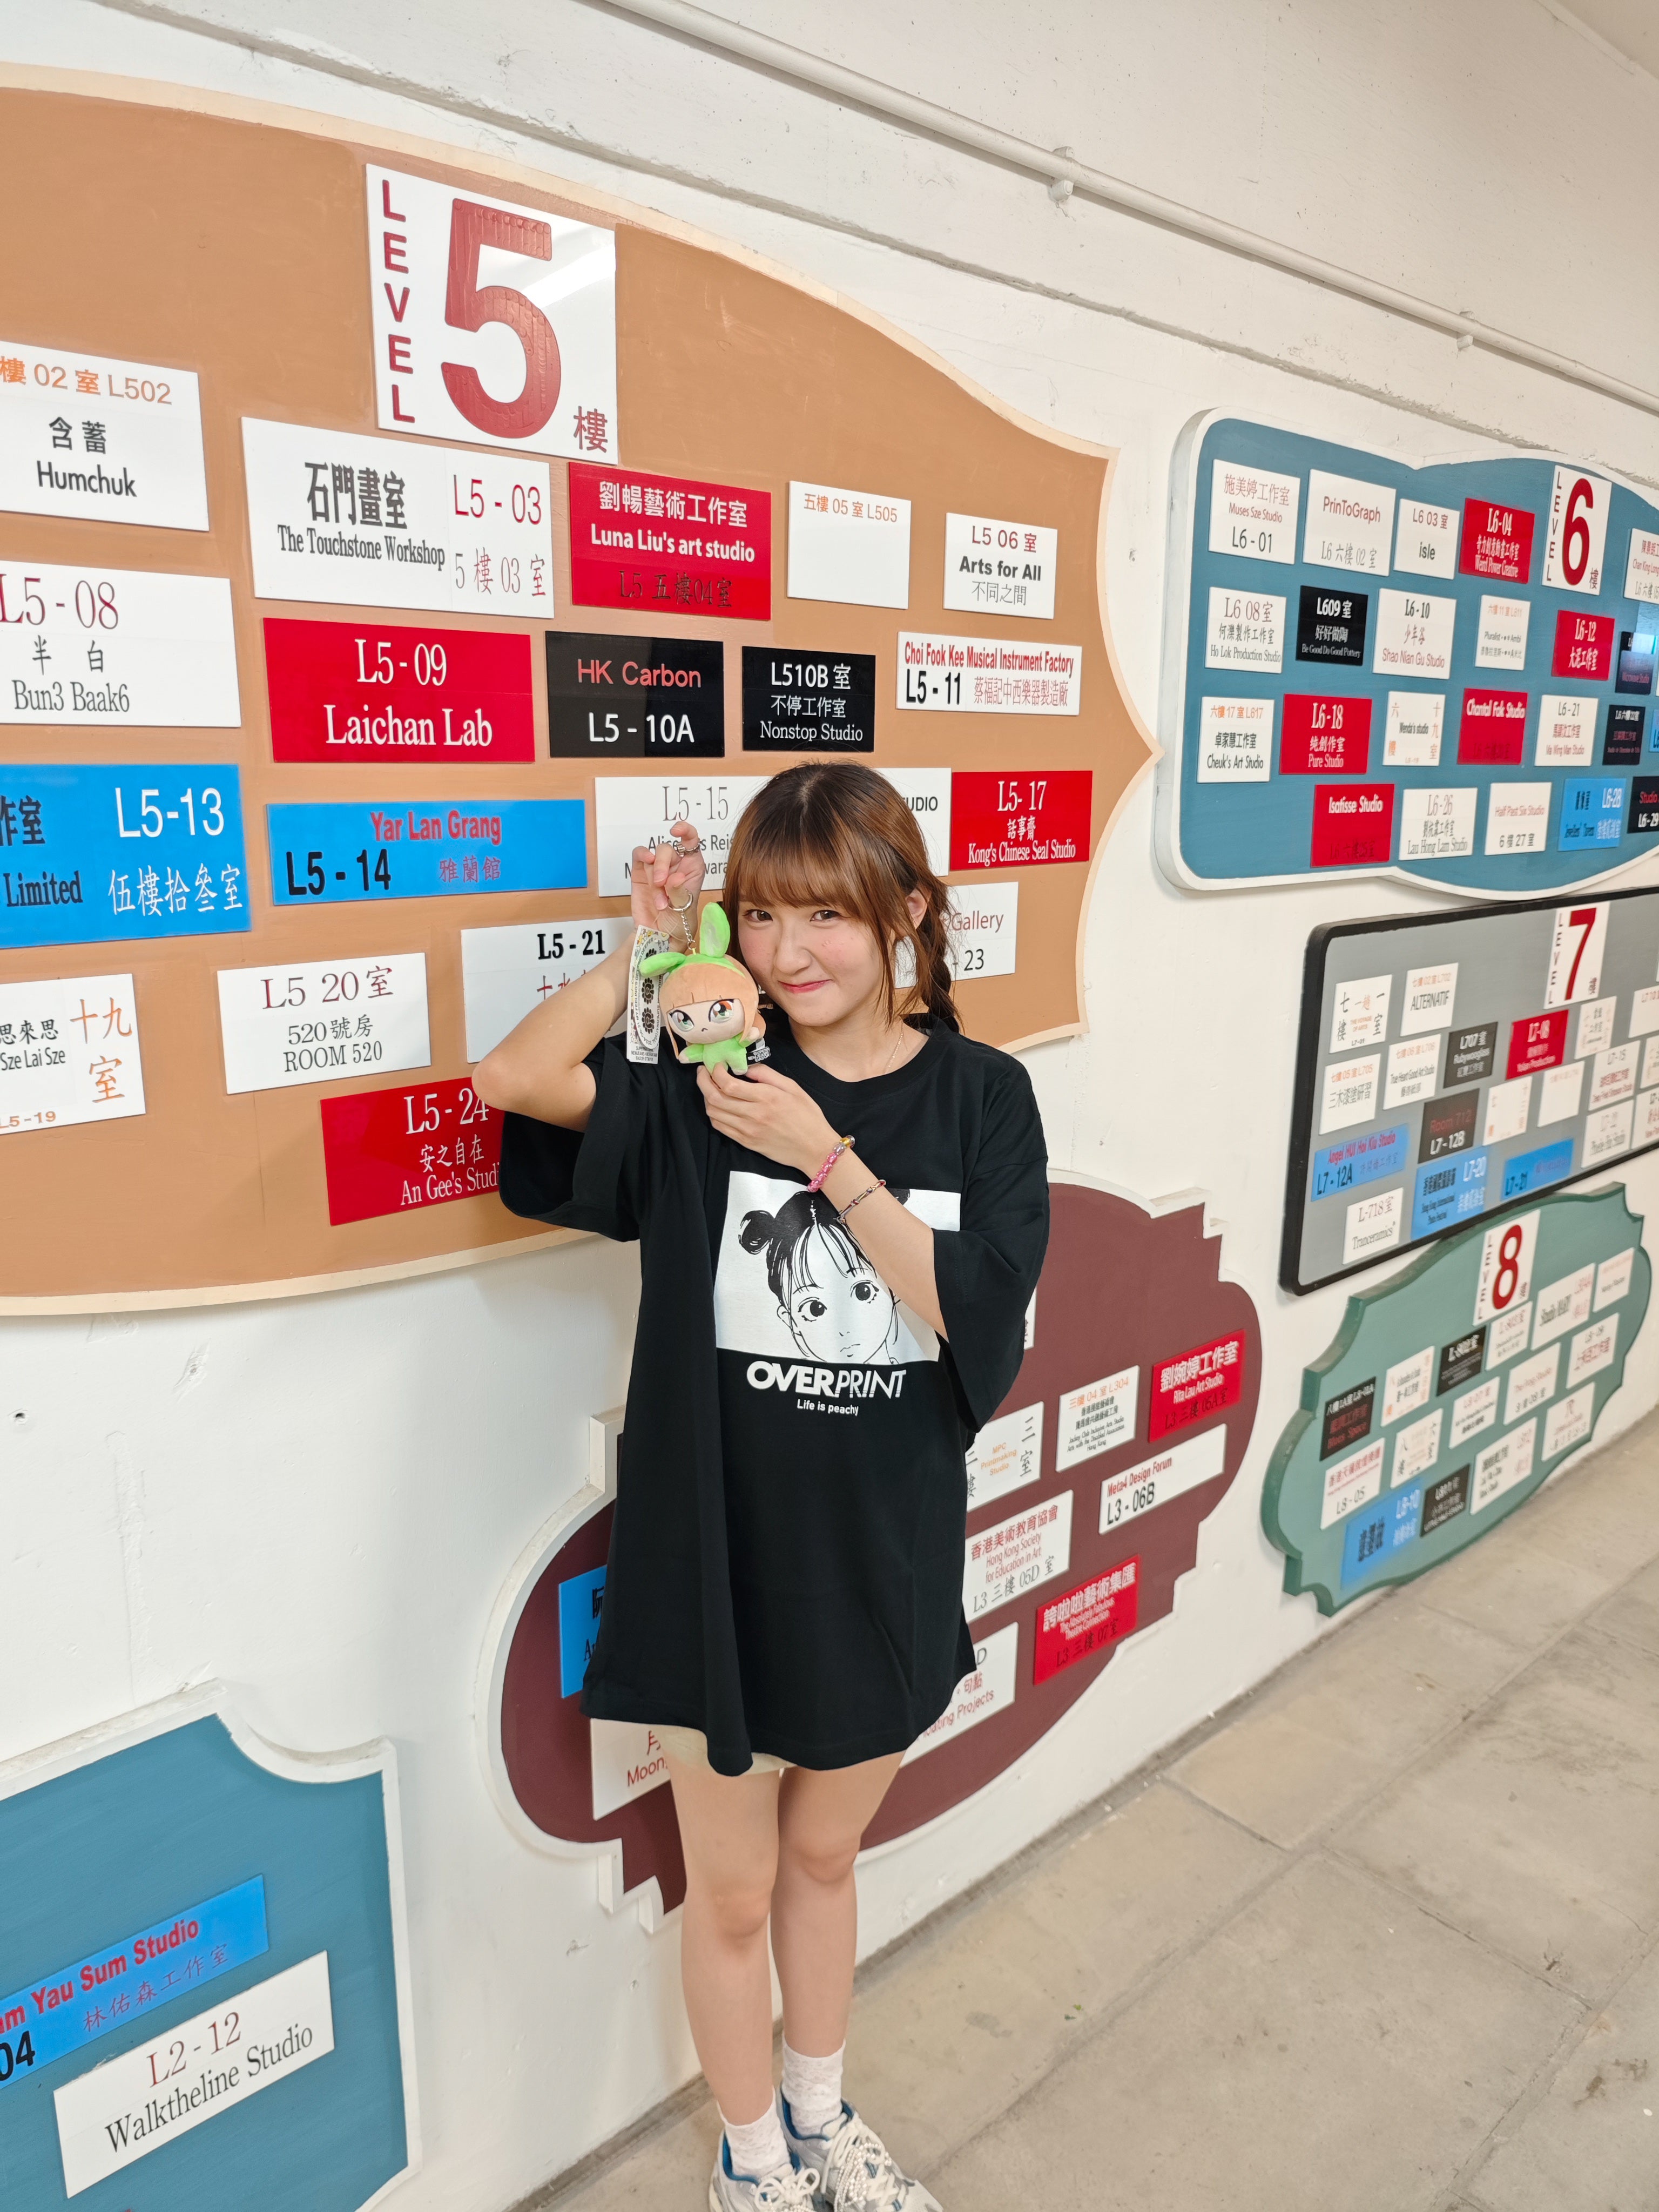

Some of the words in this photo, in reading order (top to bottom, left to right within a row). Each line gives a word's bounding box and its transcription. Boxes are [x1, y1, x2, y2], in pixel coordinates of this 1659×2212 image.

[382, 180, 415, 423] LEVEL
[441, 198, 561, 439] 5
[33, 363, 68, 390] 02
[75, 369, 100, 395] 室
[108, 374, 172, 405] L502
[573, 406, 608, 454] 樓
[36, 460, 137, 497] Humchuk
[1223, 474, 1290, 506] 施美婷工作室
[304, 462, 407, 529] 石門畫室
[599, 481, 747, 528] 劉暢藝術工作室
[804, 493, 828, 513] 五樓
[832, 498, 848, 516] 05
[852, 501, 864, 518] 室
[867, 503, 898, 523] L505
[1323, 496, 1381, 525] PrinToGraph
[1229, 502, 1249, 517] Muses
[1251, 505, 1261, 519] Sze
[1263, 508, 1282, 523] Studio
[1546, 471, 1562, 582] LEVEL
[277, 524, 304, 554] The
[307, 527, 382, 561] Touchstone
[384, 535, 445, 571] Workshop
[591, 523, 633, 549] Luna
[638, 529, 675, 554] Liu's
[679, 538, 703, 557] art
[705, 541, 755, 563] studio
[972, 525, 992, 546] L5
[997, 529, 1018, 550] 06
[1562, 478, 1594, 586] 6
[1419, 542, 1435, 560] isle
[959, 555, 993, 576] Arts
[997, 560, 1018, 578] for
[1022, 564, 1041, 582] All
[971, 581, 1027, 606] 不同之間
[577, 658, 613, 685] HK
[622, 660, 701, 687] Carbon
[771, 662, 828, 687] L510B
[905, 641, 924, 665] Choi
[926, 643, 946, 667] Fook
[948, 644, 965, 668] Kee
[966, 646, 997, 670] Musical
[1000, 649, 1043, 672] Instrument
[1045, 651, 1074, 679] Factory
[1382, 648, 1398, 663] Shao
[1400, 650, 1414, 664] Nian
[1416, 652, 1424, 666] Gu
[1426, 653, 1445, 668] Studio
[11, 679, 64, 711] Bun3
[70, 682, 130, 712] Baak6
[771, 694, 846, 719] 不停工作室
[1506, 701, 1525, 719] Studio
[323, 704, 436, 746] Laichan
[442, 707, 493, 747] Lab
[760, 720, 817, 742] Nonstop
[821, 724, 864, 742] Studio
[1207, 755, 1231, 769] Cheuk's
[1233, 755, 1243, 769] Art
[1245, 755, 1264, 769] Studio
[1308, 753, 1323, 767] Pure
[1324, 754, 1344, 768] Studio
[114, 787, 224, 838] L5-13
[1359, 794, 1383, 813] Studio
[370, 811, 403, 842] Yar
[408, 811, 442, 840] Lan
[448, 810, 502, 845] Grang
[439, 855, 502, 884] 雅蘭館
[968, 842, 996, 867] Kong's
[999, 841, 1030, 862] Chinese
[1032, 840, 1049, 860] Seal
[1051, 839, 1076, 859] Studio
[3, 871, 84, 907] Limited
[951, 911, 1004, 933] Gallery
[1564, 907, 1597, 1001] 7
[260, 976, 306, 1009] L5
[1410, 990, 1450, 1011] ALTERNATIF
[0, 1051, 22, 1071] Sze
[25, 1049, 42, 1068] Lai
[45, 1047, 66, 1066] Sze
[283, 1046, 347, 1073] ROOM
[353, 1041, 382, 1064] 520
[420, 1134, 485, 1173] 安之自在
[401, 1179, 422, 1206] An
[427, 1171, 463, 1202] Gee's
[467, 1162, 500, 1191] Studi
[1492, 1224, 1522, 1310] 8
[746, 1360, 907, 1399] OVERPRINT
[1160, 1340, 1239, 1393] 劉婉婷工作室
[1174, 1390, 1185, 1404] Rita
[1185, 1386, 1196, 1399] Lau
[1196, 1380, 1204, 1394] Art
[1205, 1372, 1224, 1391] Studio
[797, 1399, 814, 1411] Life
[817, 1401, 826, 1411] is
[827, 1403, 859, 1417] peachy
[981, 1451, 1016, 1471] Printmaking
[989, 1462, 1009, 1476] Studio
[1129, 1467, 1150, 1489] Design
[1152, 1456, 1172, 1479] Forum
[970, 1505, 1058, 1561] 香港美術教育協會
[986, 1552, 1002, 1568] Hong
[1003, 1544, 1019, 1557] Kong
[1021, 1532, 1042, 1550] Society
[995, 1556, 1024, 1579] Education
[1032, 1546, 1042, 1560] Art
[956, 1690, 994, 1722] Projects
[31, 1978, 74, 2015] Yau
[79, 1954, 127, 1992] Sum
[133, 1918, 198, 1965] Studio
[83, 1943, 228, 2033] 林佑森工作室
[105, 2065, 239, 2154] Walktheline
[247, 2023, 313, 2078] Studio
